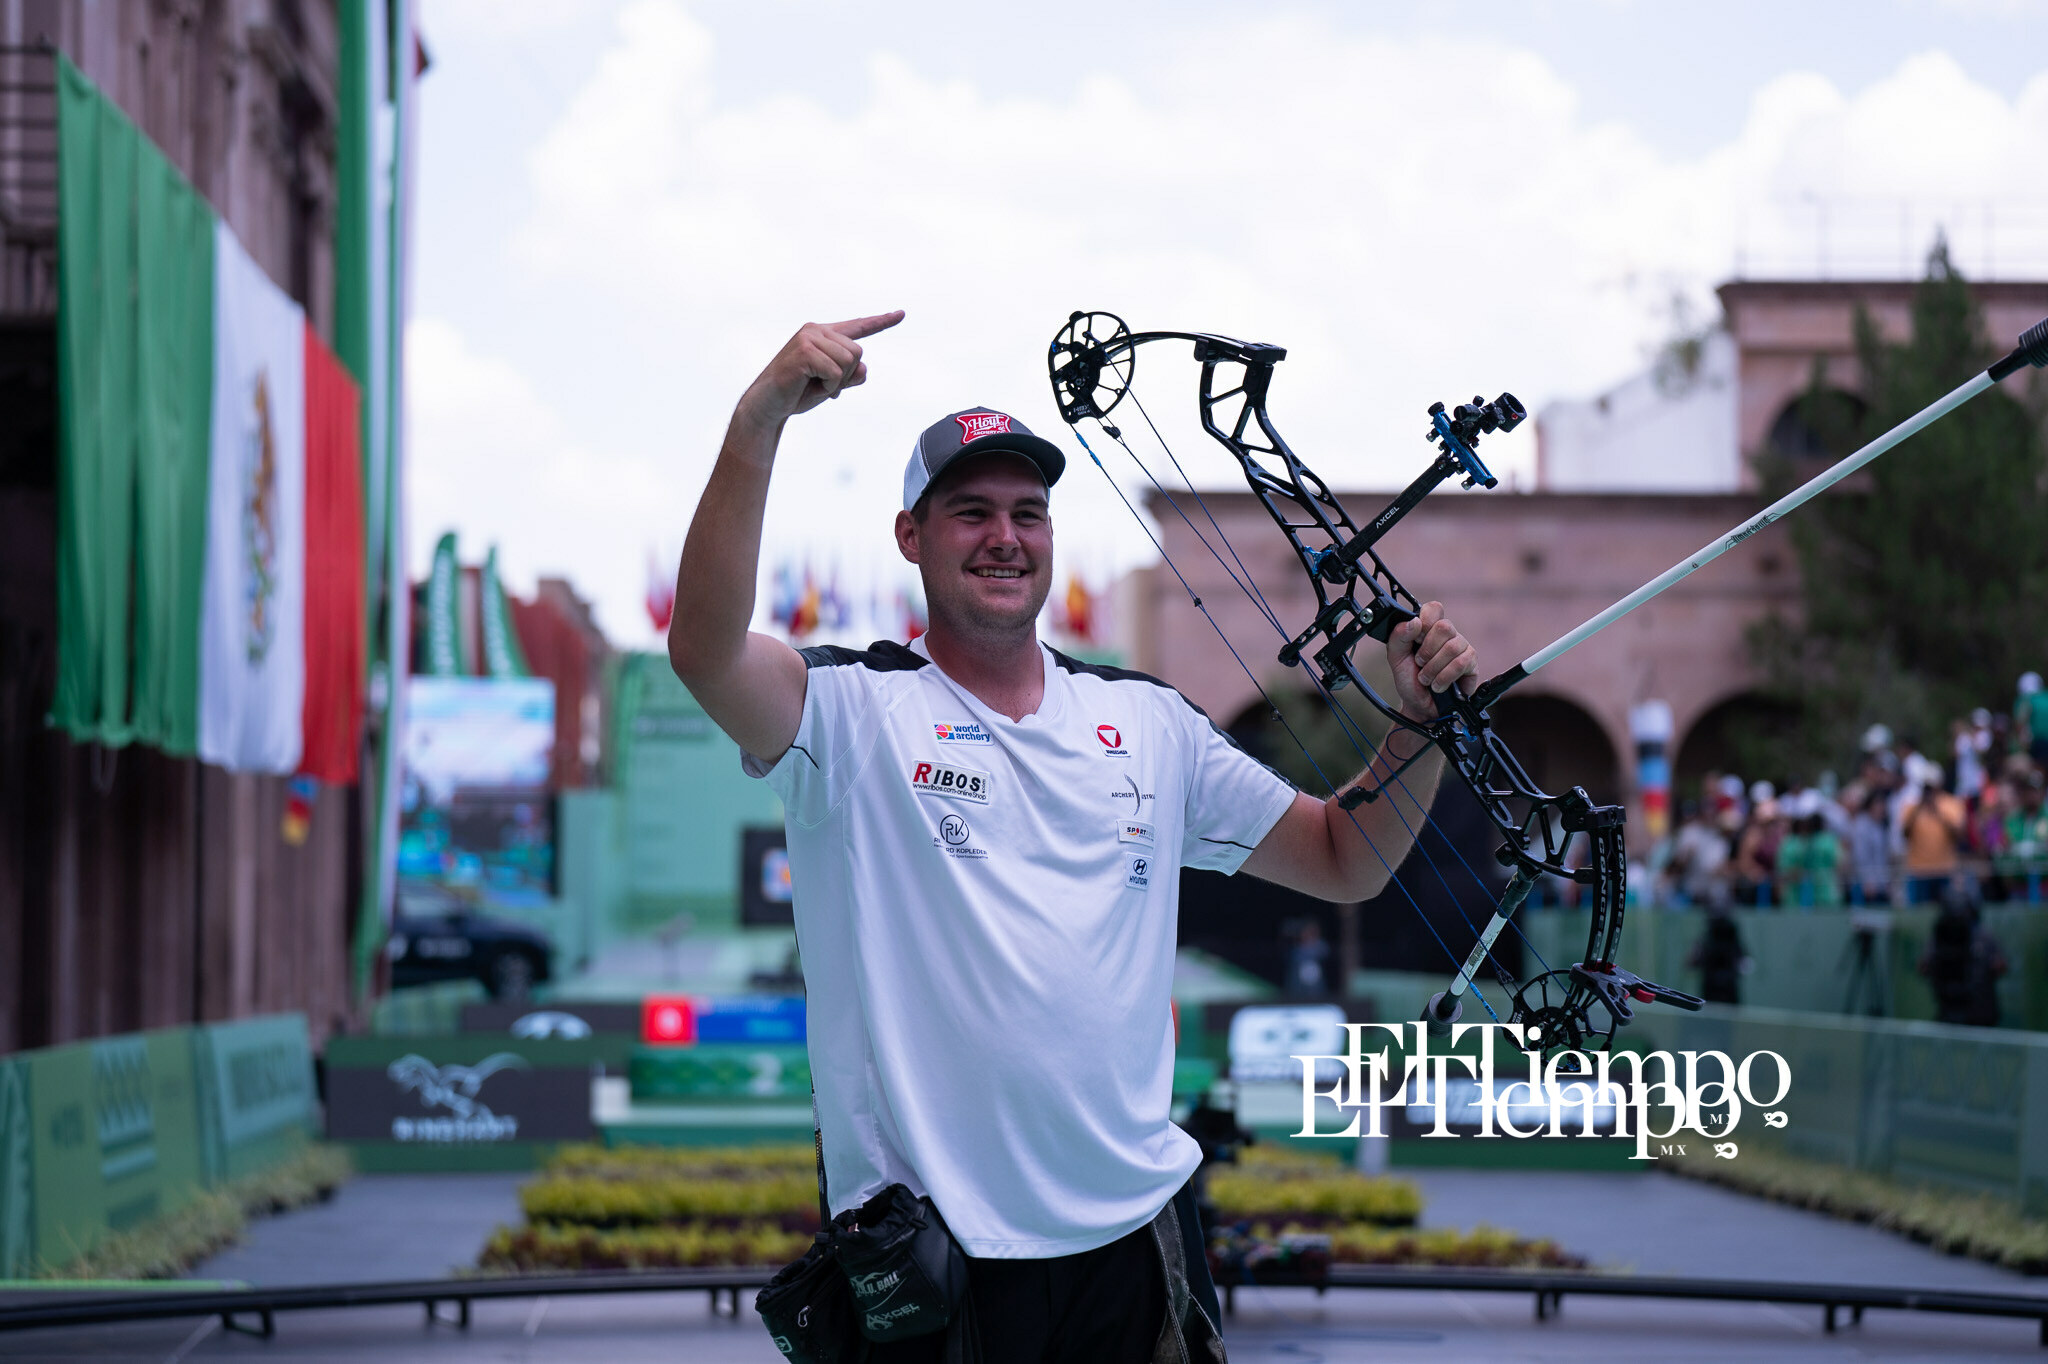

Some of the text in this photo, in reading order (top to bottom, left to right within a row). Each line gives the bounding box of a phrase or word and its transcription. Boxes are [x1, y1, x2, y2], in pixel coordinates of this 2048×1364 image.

[968, 414, 1004, 430] Hoyt
[1376, 506, 1400, 528] AXCEL
[956, 732, 990, 742] archery
[913, 763, 980, 792] RIBOS
